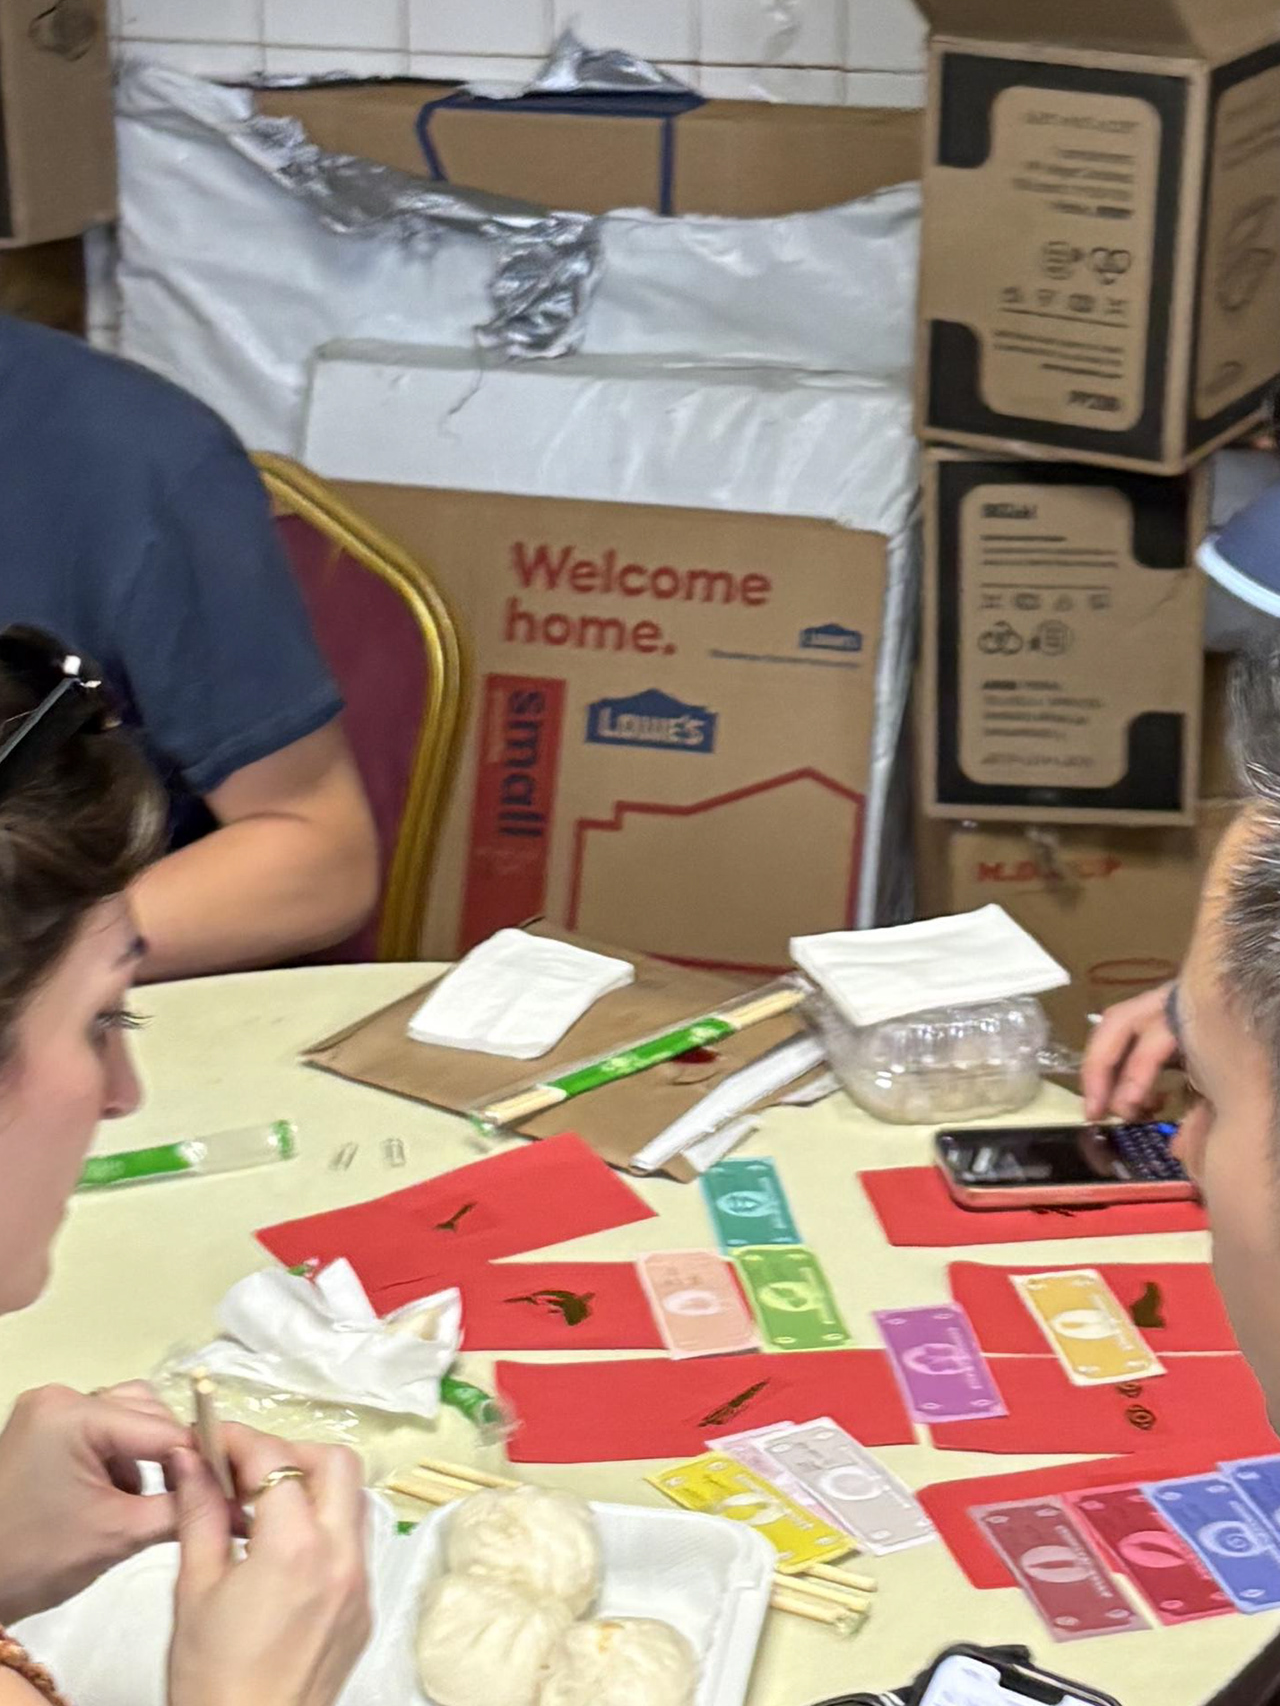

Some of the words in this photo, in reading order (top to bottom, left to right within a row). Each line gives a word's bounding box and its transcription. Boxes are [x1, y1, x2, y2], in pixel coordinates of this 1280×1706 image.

[509, 540, 772, 607] Welcome
[502, 597, 677, 656] home.
[497, 690, 547, 838] small
